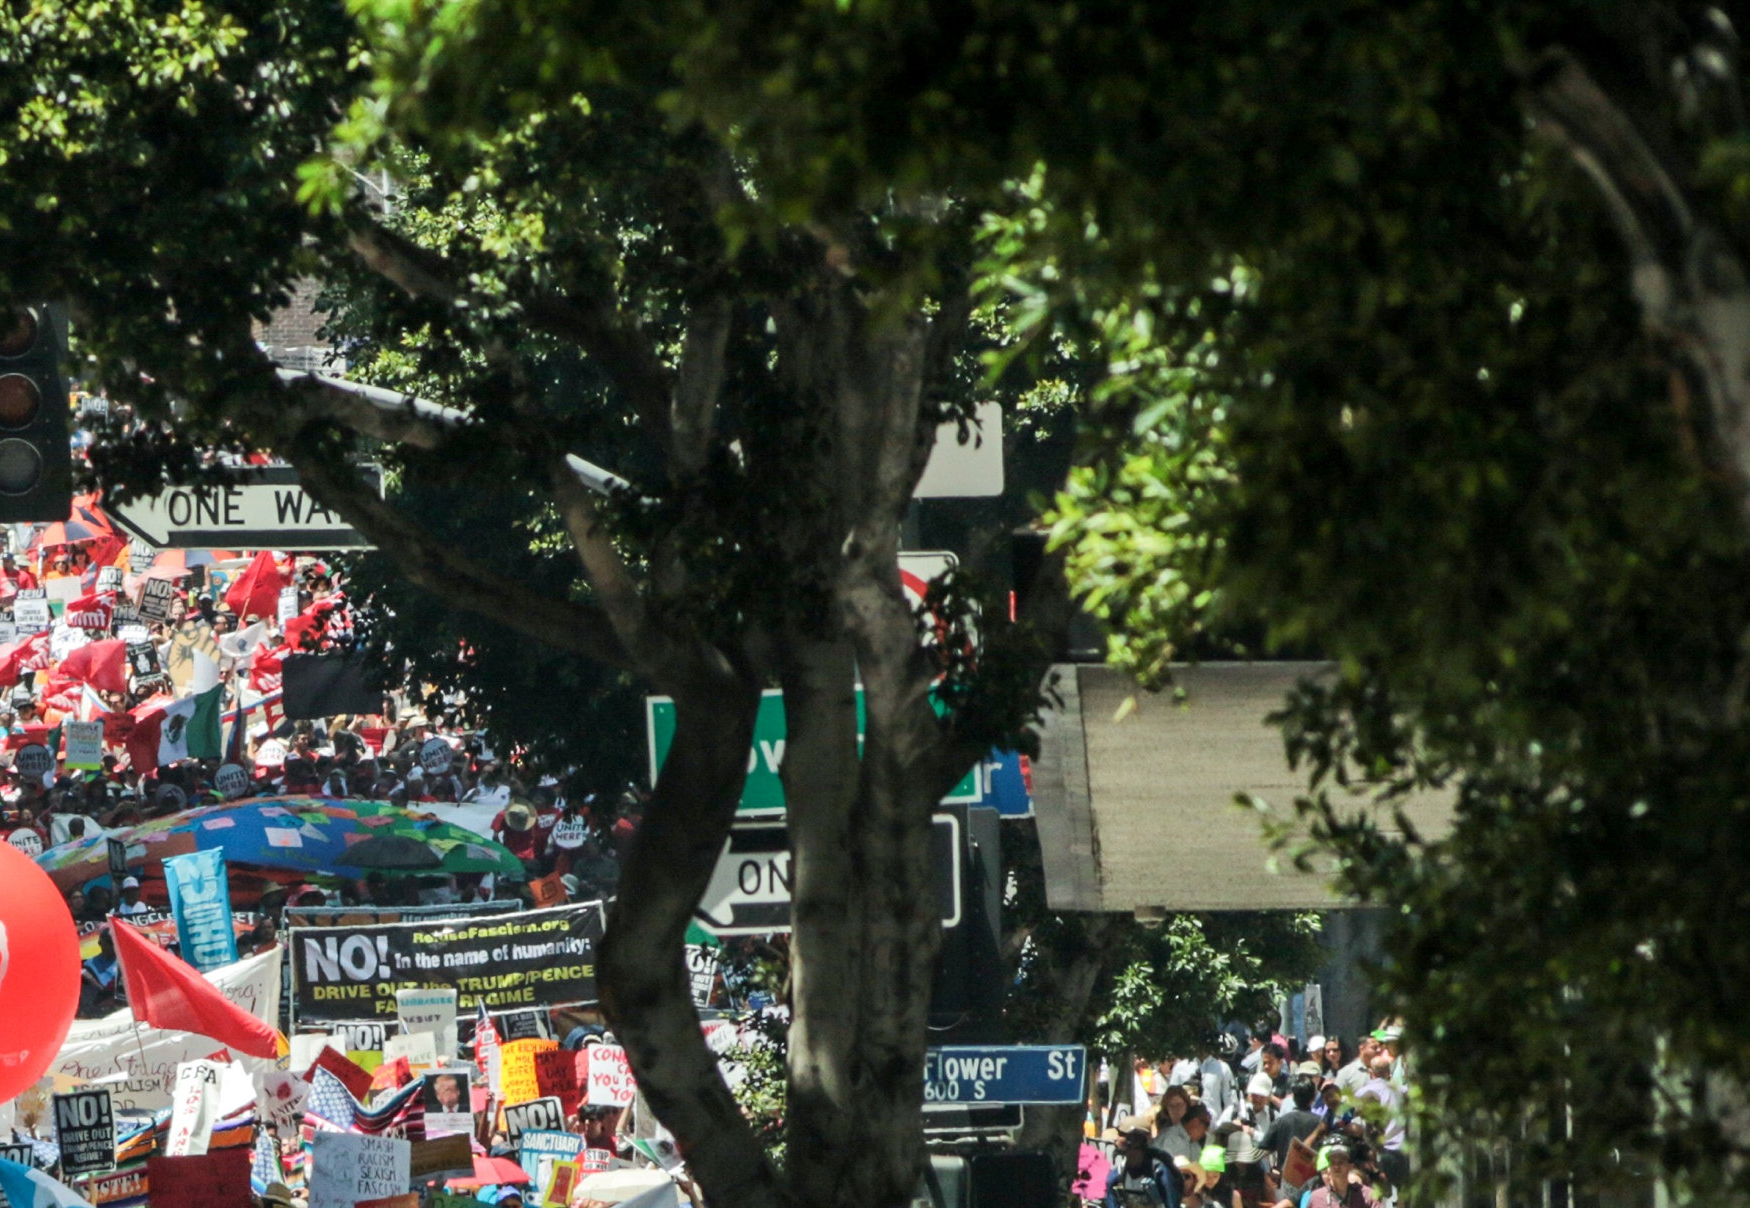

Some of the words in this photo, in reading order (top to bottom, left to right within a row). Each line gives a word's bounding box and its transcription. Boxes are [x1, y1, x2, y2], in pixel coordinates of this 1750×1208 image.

[168, 490, 245, 526] ONE
[275, 490, 333, 524] WA
[17, 589, 44, 600] SEIU
[149, 579, 172, 597] NO!
[19, 752, 50, 763] UNITE
[216, 771, 247, 785] UNITE
[555, 832, 588, 841] HERE!
[557, 822, 587, 833] UNITE
[738, 857, 791, 894] ON
[304, 935, 390, 982] NO!
[413, 919, 570, 944] RefuseFascism.org
[396, 953, 411, 969] In
[415, 951, 441, 969] the
[443, 948, 488, 967] name
[492, 947, 510, 963] of
[512, 937, 592, 961] humanity:
[314, 984, 373, 1000] DRIVE
[456, 964, 596, 989] TRUMP/PENCE
[458, 987, 536, 1009] REGIME
[337, 1025, 382, 1050] NO!
[924, 1052, 1008, 1081] Flower
[1047, 1051, 1076, 1080] St
[593, 1073, 619, 1088] YOU
[924, 1081, 959, 1101] 600
[974, 1081, 986, 1100] S
[58, 1094, 110, 1128] NO!
[505, 1101, 556, 1136] NO!
[63, 1129, 89, 1143] DRIVE
[91, 1127, 112, 1140] OUT
[522, 1131, 582, 1153] SANCTUARY
[361, 1138, 394, 1152] SMASH
[358, 1152, 395, 1165] RACISM
[360, 1166, 396, 1180] SEXISM
[357, 1180, 401, 1195] FASCISM
